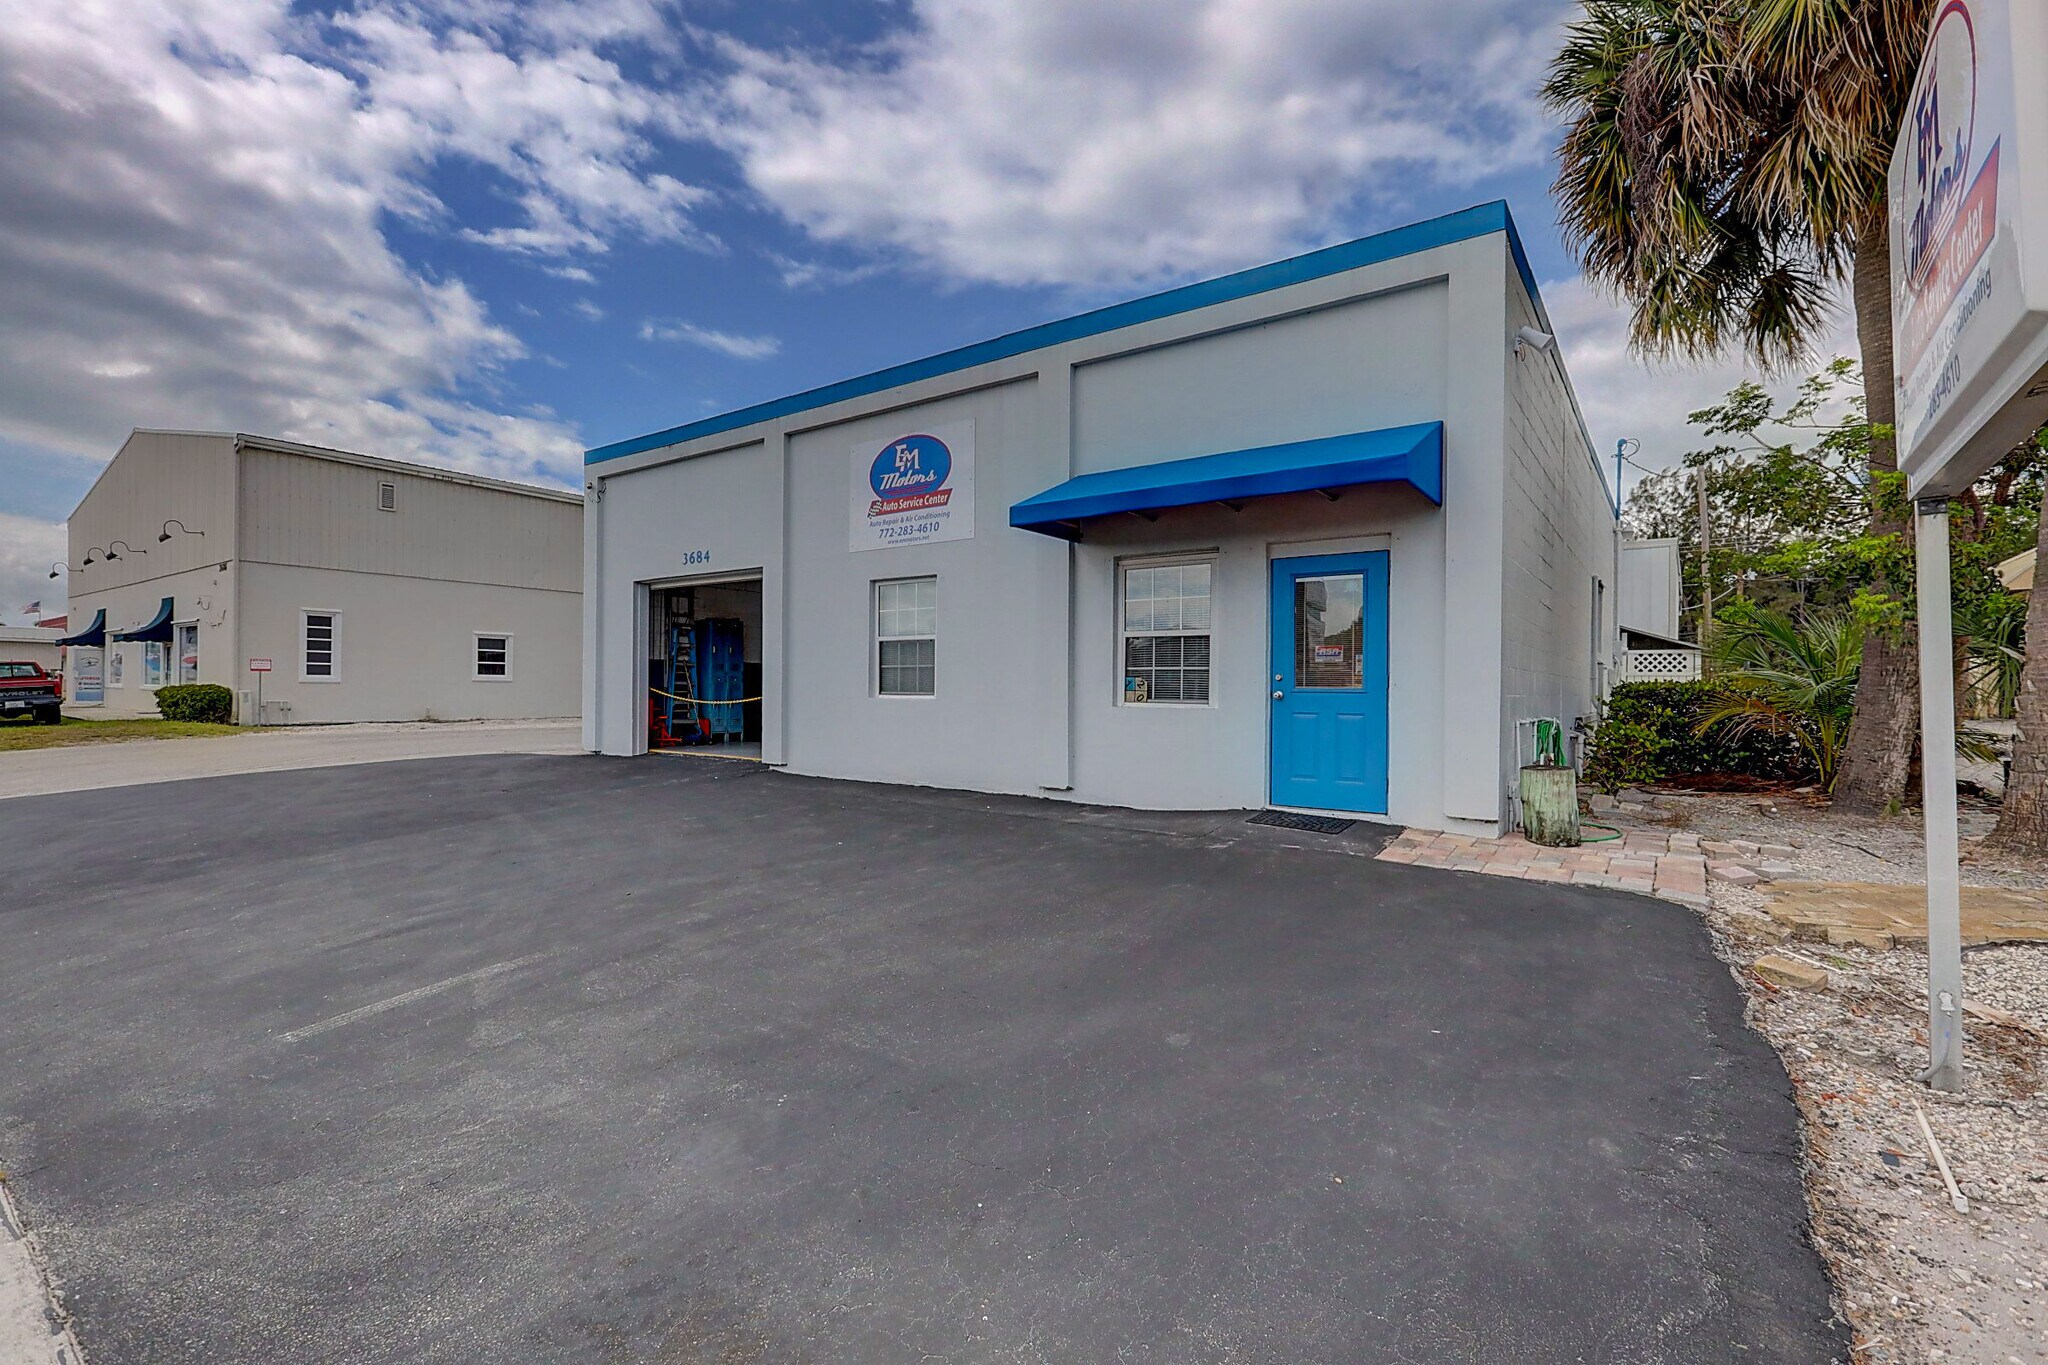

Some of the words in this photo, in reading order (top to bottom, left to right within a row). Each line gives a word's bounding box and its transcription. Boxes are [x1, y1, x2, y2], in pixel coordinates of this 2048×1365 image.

[1924, 259, 1951, 316] Service
[1951, 197, 1983, 284] Center
[1945, 267, 1991, 350] Conditioning
[880, 469, 937, 490] Motors
[882, 501, 899, 511] Auto
[899, 497, 923, 509] Service
[924, 493, 948, 505] Center
[869, 520, 882, 528] Auto
[882, 518, 899, 527] Repair
[905, 515, 914, 523] Air
[914, 511, 950, 522] Conditioning
[879, 522, 940, 539] 772-283-4610
[682, 546, 710, 556] 3684
